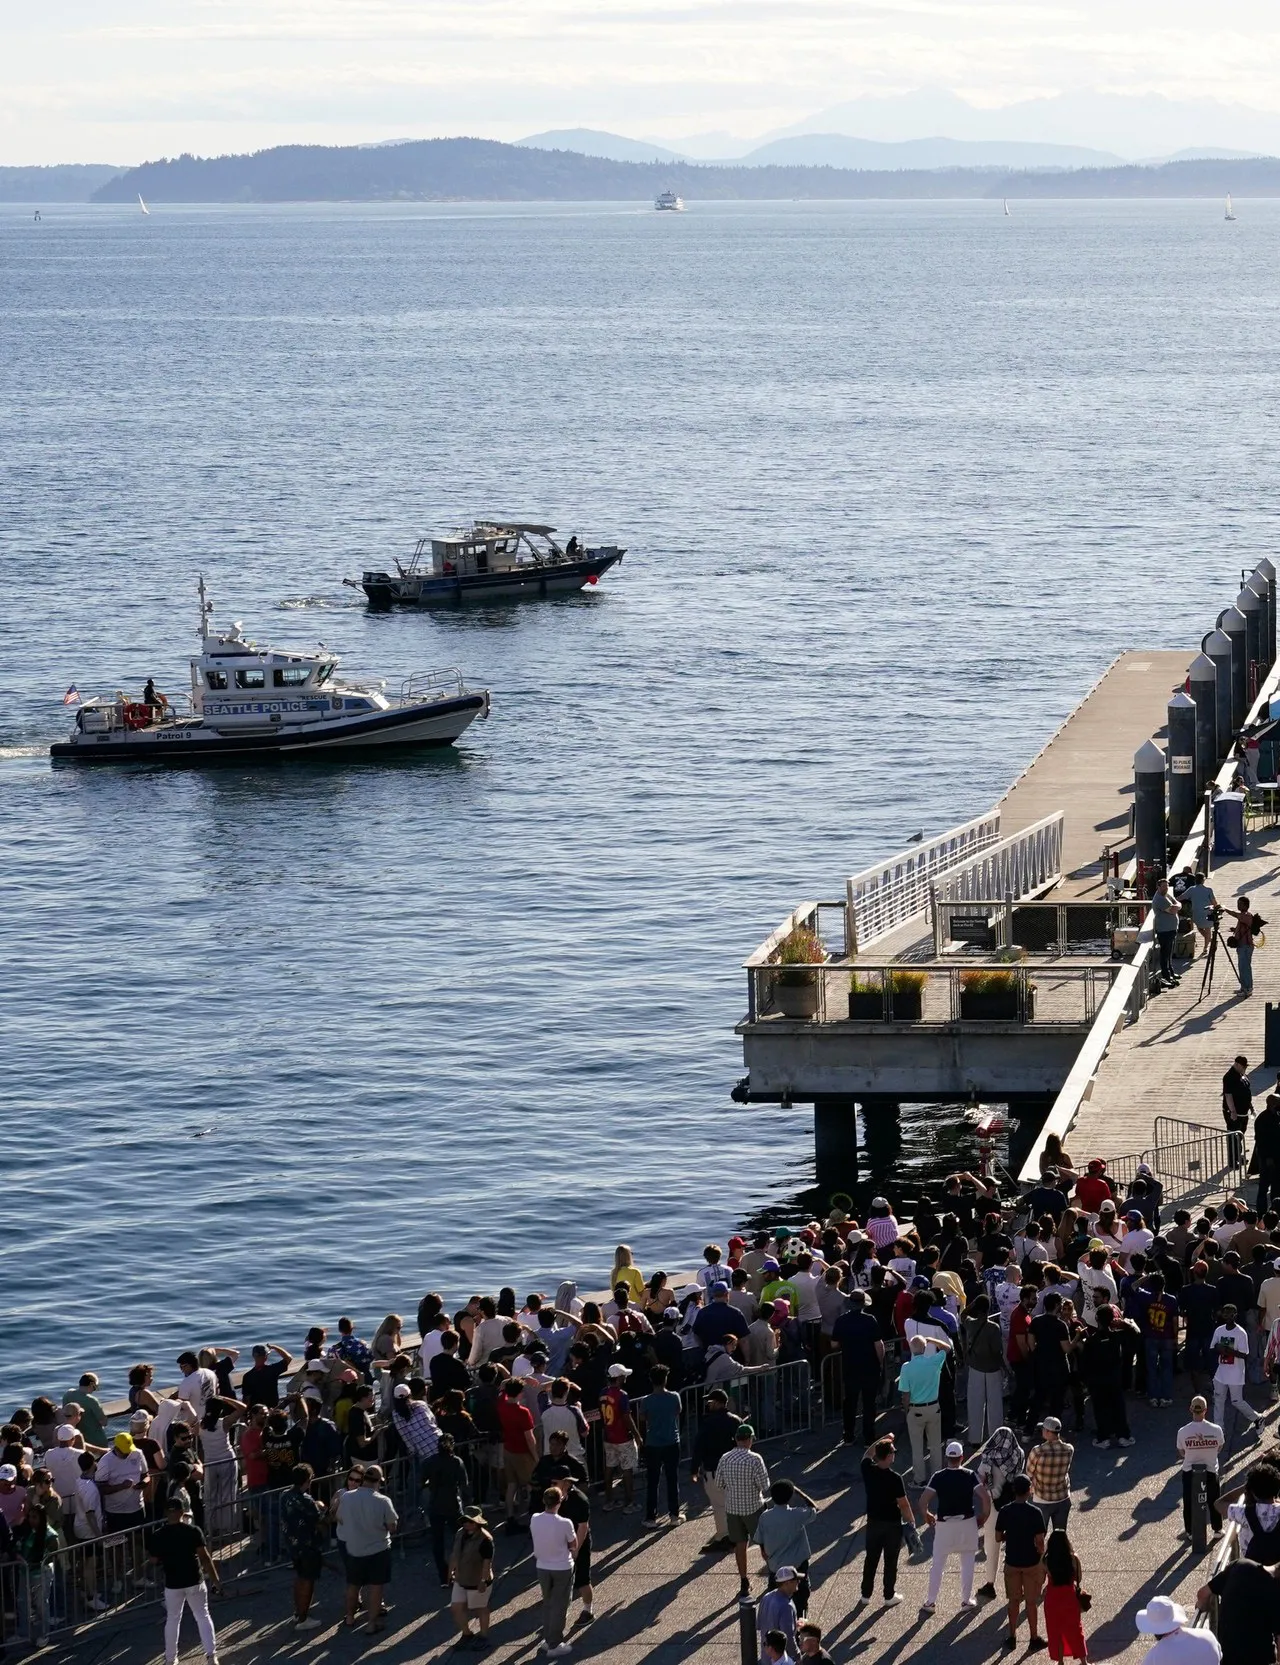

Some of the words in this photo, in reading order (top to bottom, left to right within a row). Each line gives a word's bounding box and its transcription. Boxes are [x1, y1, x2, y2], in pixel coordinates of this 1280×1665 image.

[204, 703, 260, 715] SEATTLE
[262, 702, 308, 712] POLICE
[156, 731, 184, 740] Patrol
[186, 731, 192, 739] 9
[1149, 1308, 1166, 1327] 10
[601, 1404, 614, 1425] 19
